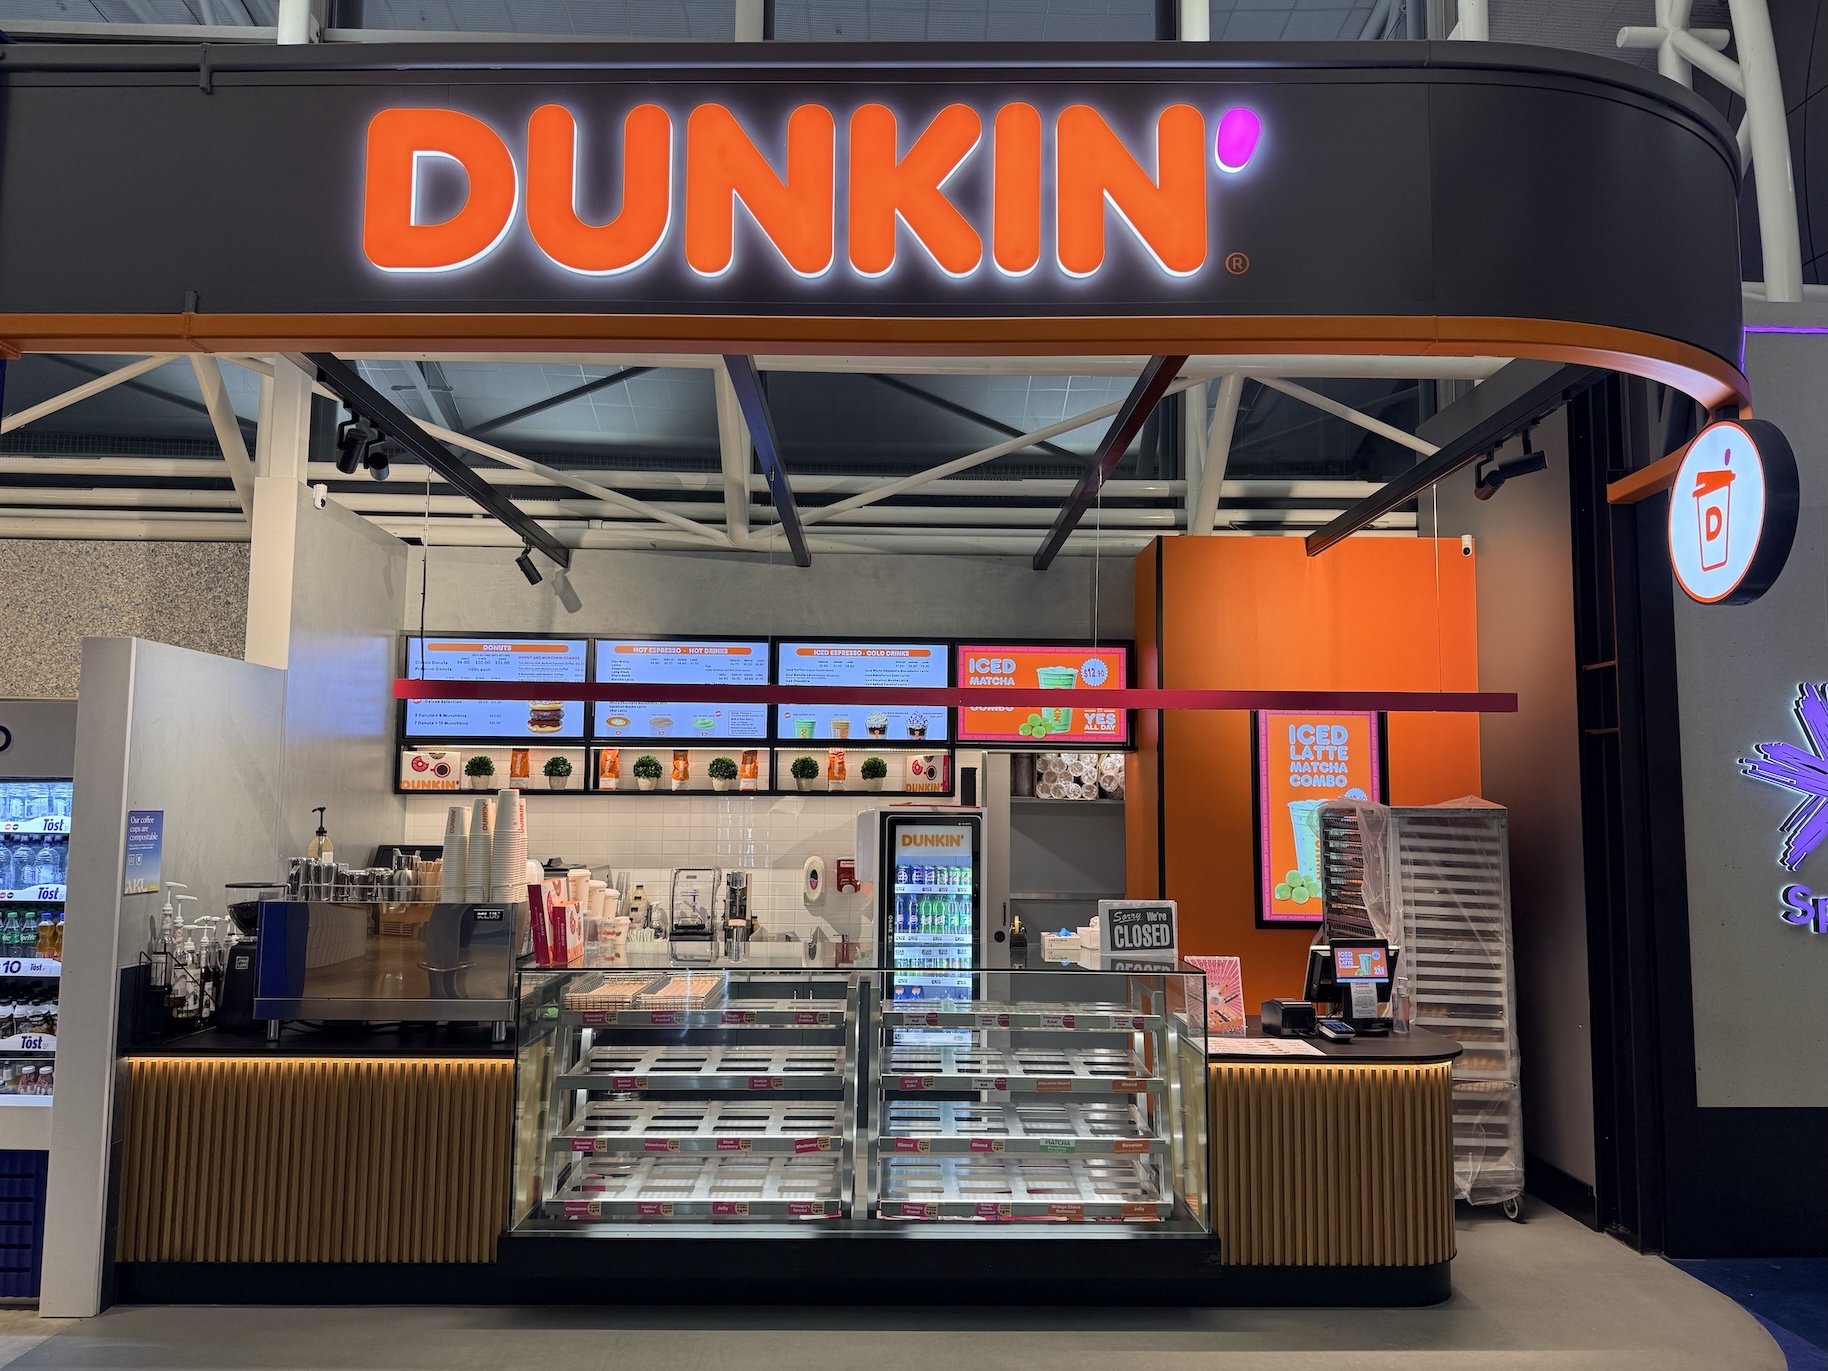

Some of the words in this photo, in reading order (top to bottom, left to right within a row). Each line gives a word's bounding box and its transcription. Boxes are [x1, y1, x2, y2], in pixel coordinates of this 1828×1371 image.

[362, 102, 1263, 279] DUNKIN'
[1705, 506, 1723, 542] D
[968, 658, 1016, 674] ICED
[1084, 667, 1105, 678] $12.90
[969, 676, 1016, 686] MATCHA
[1084, 712, 1116, 725] YES
[1288, 724, 1348, 746] ICED
[1290, 746, 1348, 761] LATTE
[1290, 762, 1348, 773] MATCHA
[401, 780, 460, 789] DUNKIN'
[906, 783, 943, 792] DUNKIN'
[1289, 774, 1348, 788] COMBO
[140, 816, 154, 824] coffee
[130, 832, 158, 841] compostable
[902, 834, 964, 847] DUNKIN'
[1112, 911, 1142, 923] Sorry
[1146, 911, 1167, 922] We're
[1114, 924, 1171, 948] CLOSED
[2, 960, 21, 974] 10
